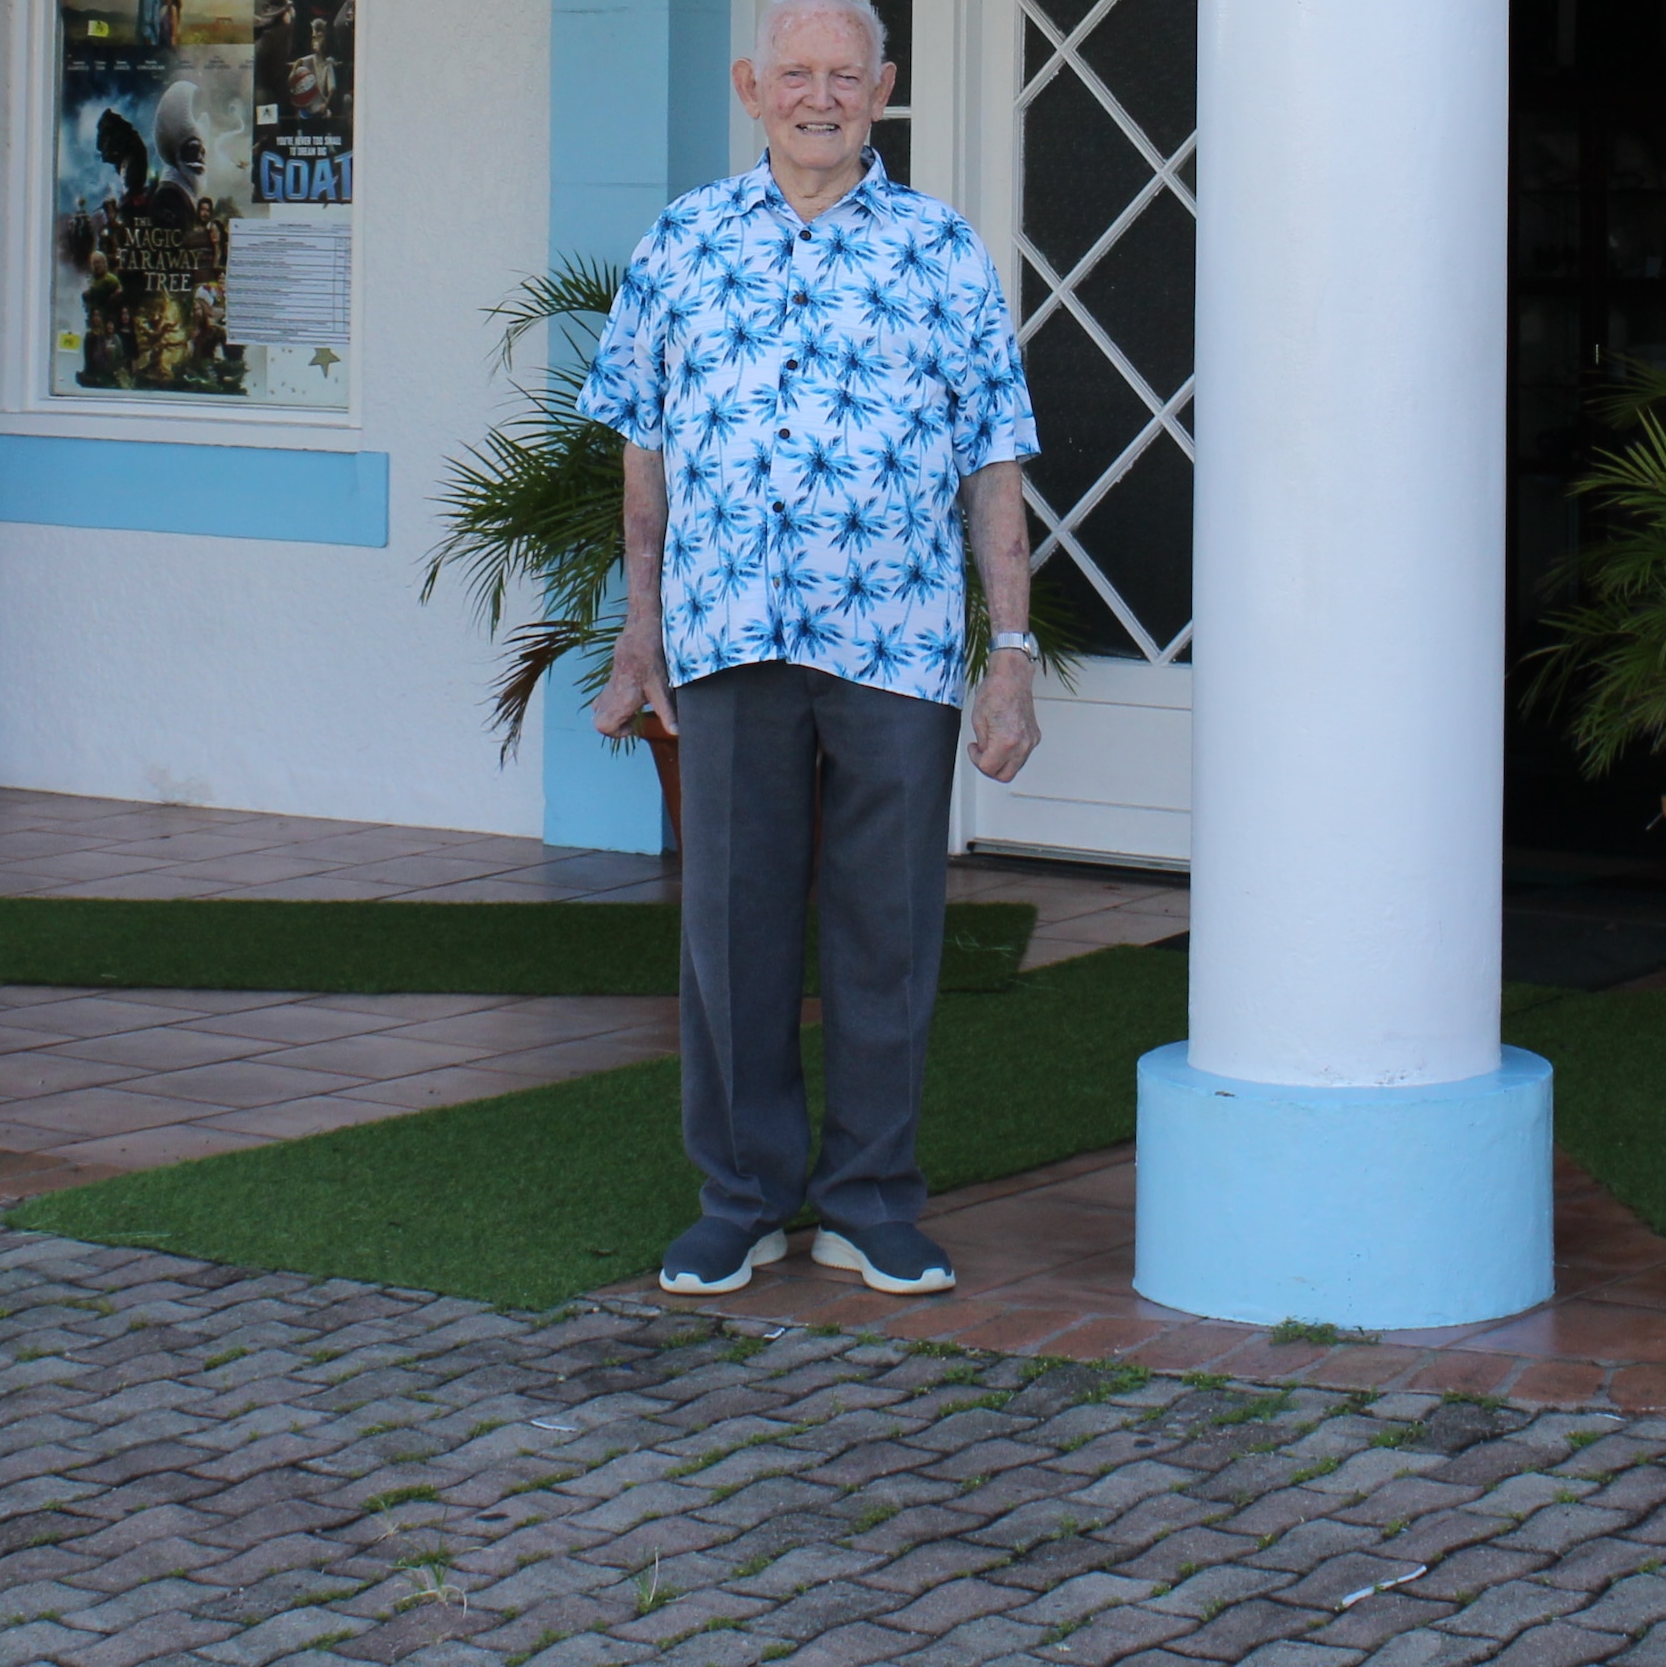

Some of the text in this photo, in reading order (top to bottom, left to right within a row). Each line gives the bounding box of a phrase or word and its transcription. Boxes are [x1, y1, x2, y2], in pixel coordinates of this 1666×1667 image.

[260, 150, 352, 202] GOAT
[133, 216, 152, 227] THE
[124, 227, 182, 251] MAGIC
[118, 248, 200, 271] FARAWAY
[145, 271, 192, 295] TREE
